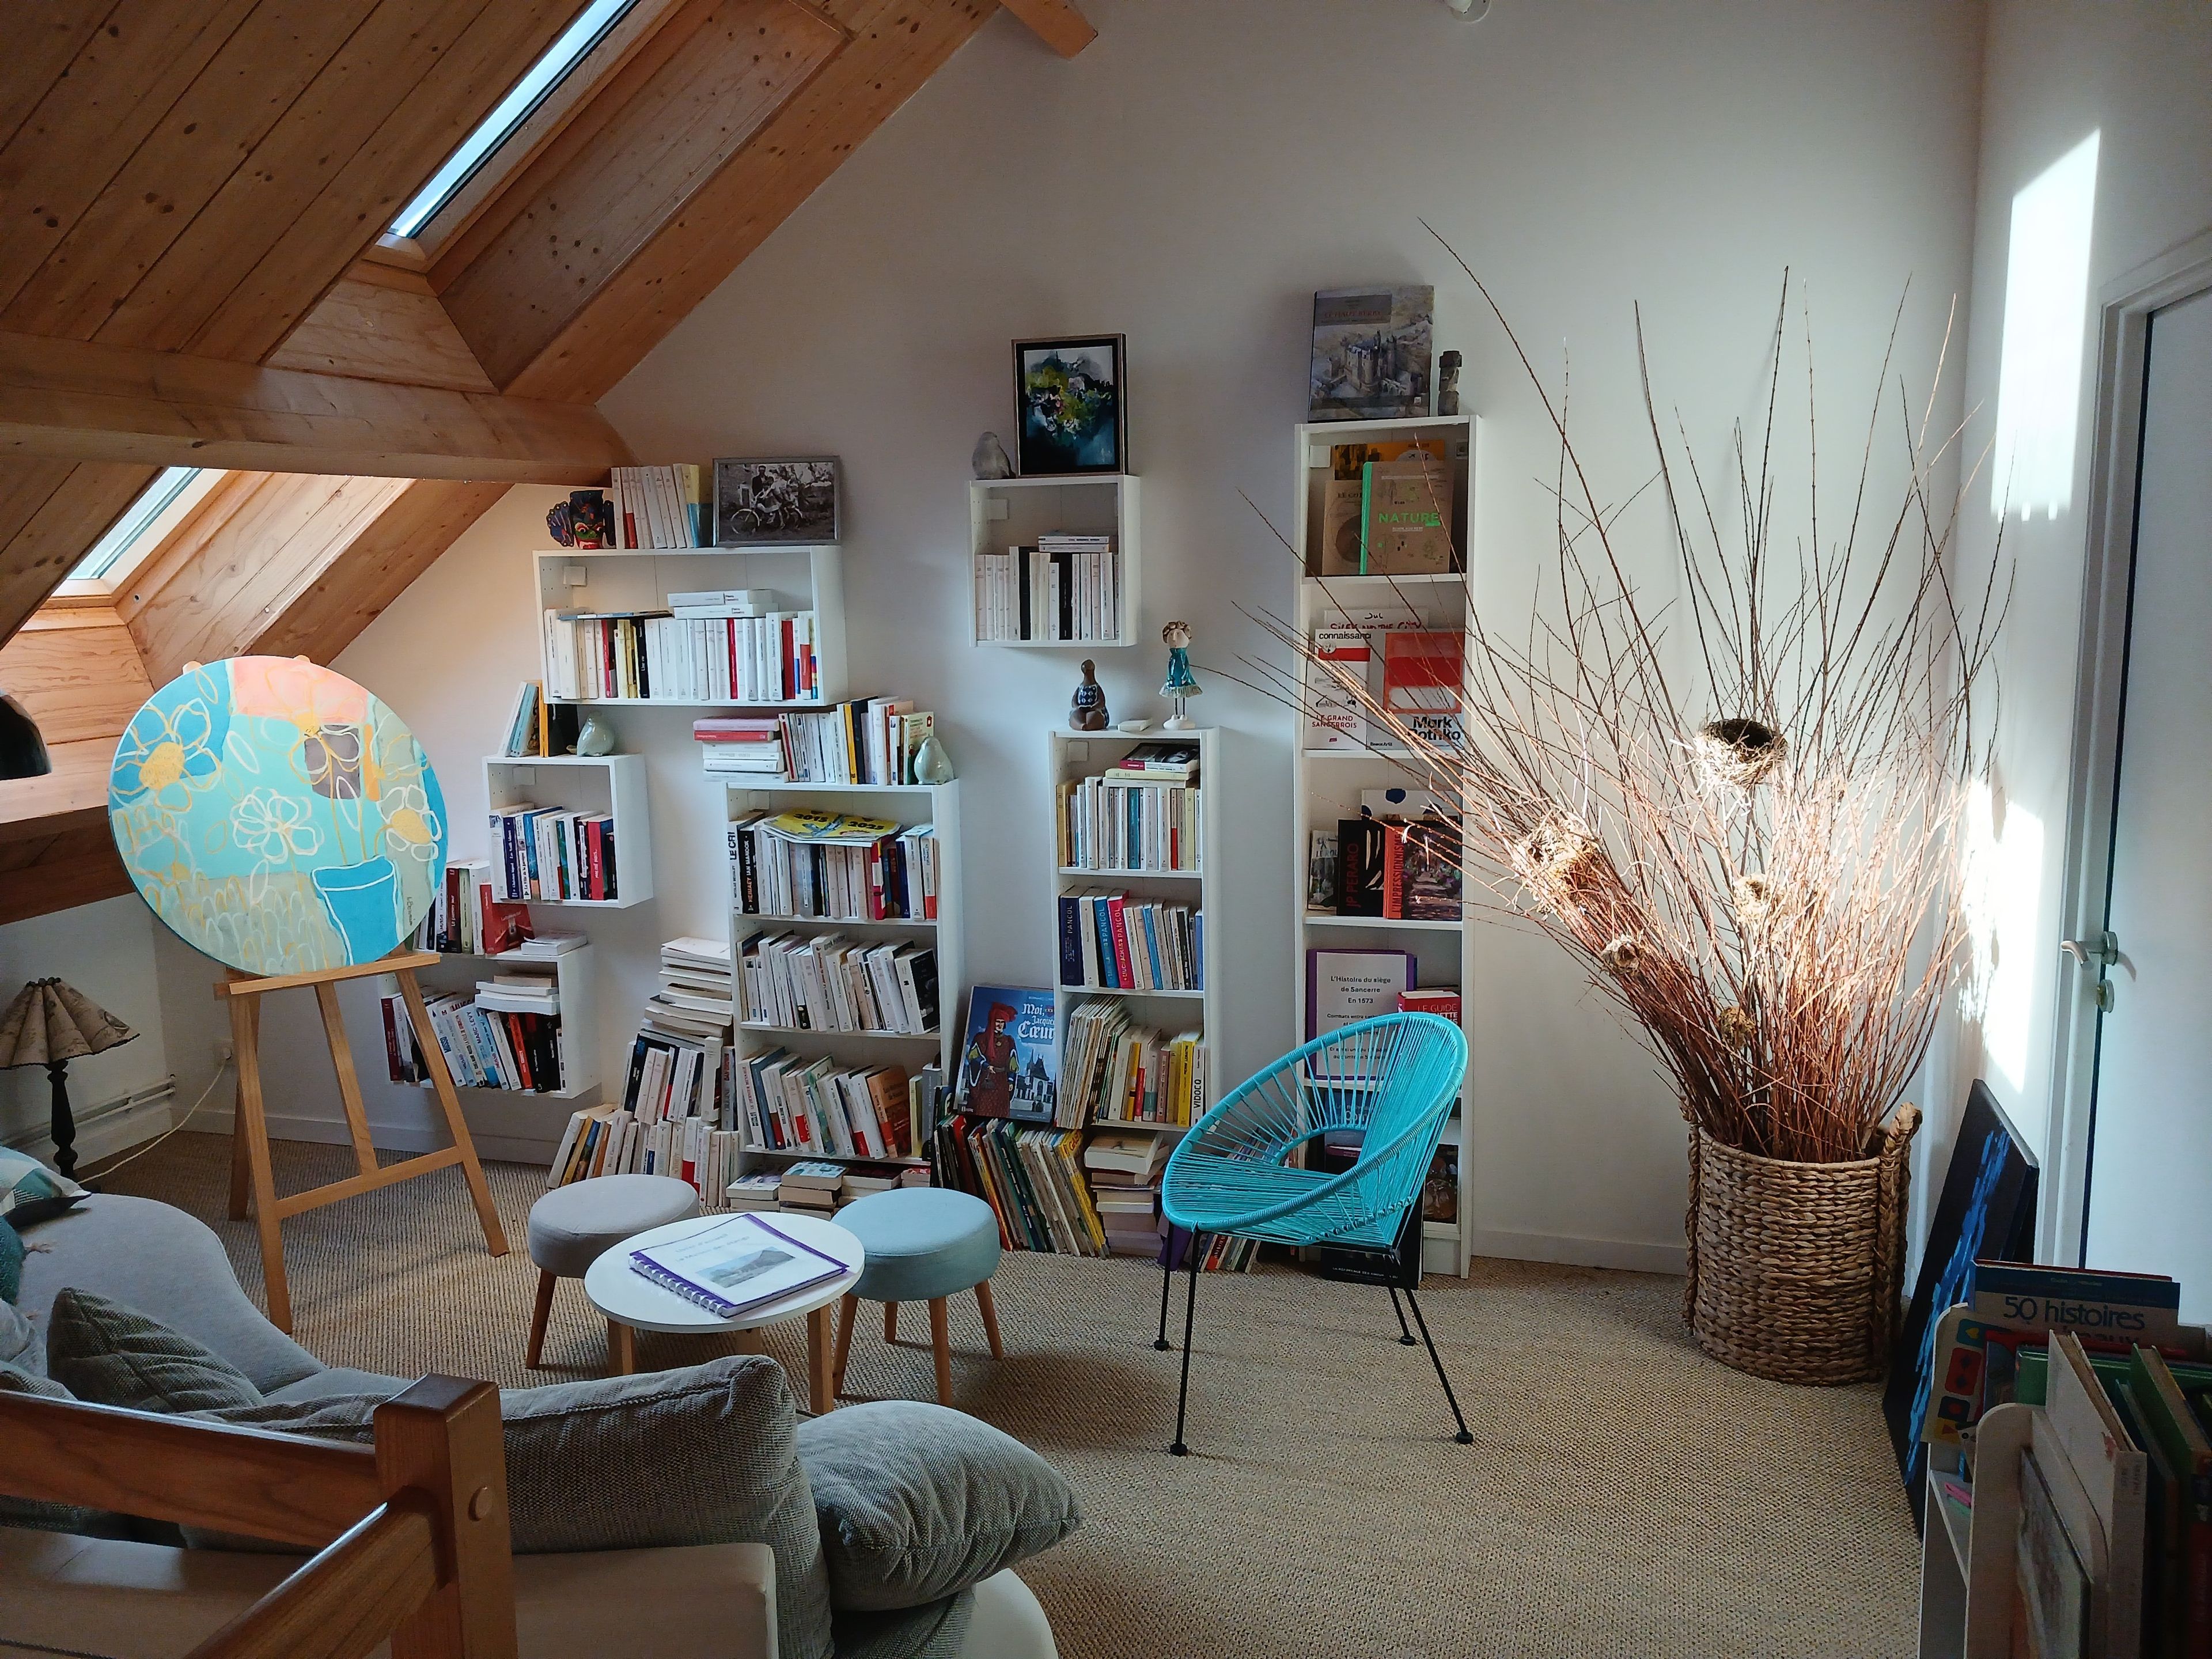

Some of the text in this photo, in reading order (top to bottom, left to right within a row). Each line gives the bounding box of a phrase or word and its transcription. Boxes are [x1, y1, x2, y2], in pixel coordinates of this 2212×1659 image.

[1378, 512, 1441, 524] NATURE
[1319, 631, 1372, 640] connaissanc
[1413, 716, 1453, 729] Mark
[794, 813, 829, 823] 2015
[848, 821, 885, 830] 2025
[728, 831, 737, 861] LE CRI
[1346, 843, 1361, 908] JP FERARO
[1391, 833, 1404, 913] L'IMPRESSIONNISME
[1100, 906, 1108, 939] PANCOL
[1373, 975, 1391, 984] siège
[1021, 1003, 1046, 1017] Moi,
[1430, 1003, 1459, 1012] GUIDE
[1031, 1015, 1055, 1026] Jacque
[467, 1011, 482, 1044] MARC LEVY
[1193, 1079, 1202, 1108] VIDOCQ
[2003, 1296, 2146, 1331] 50 histoires
